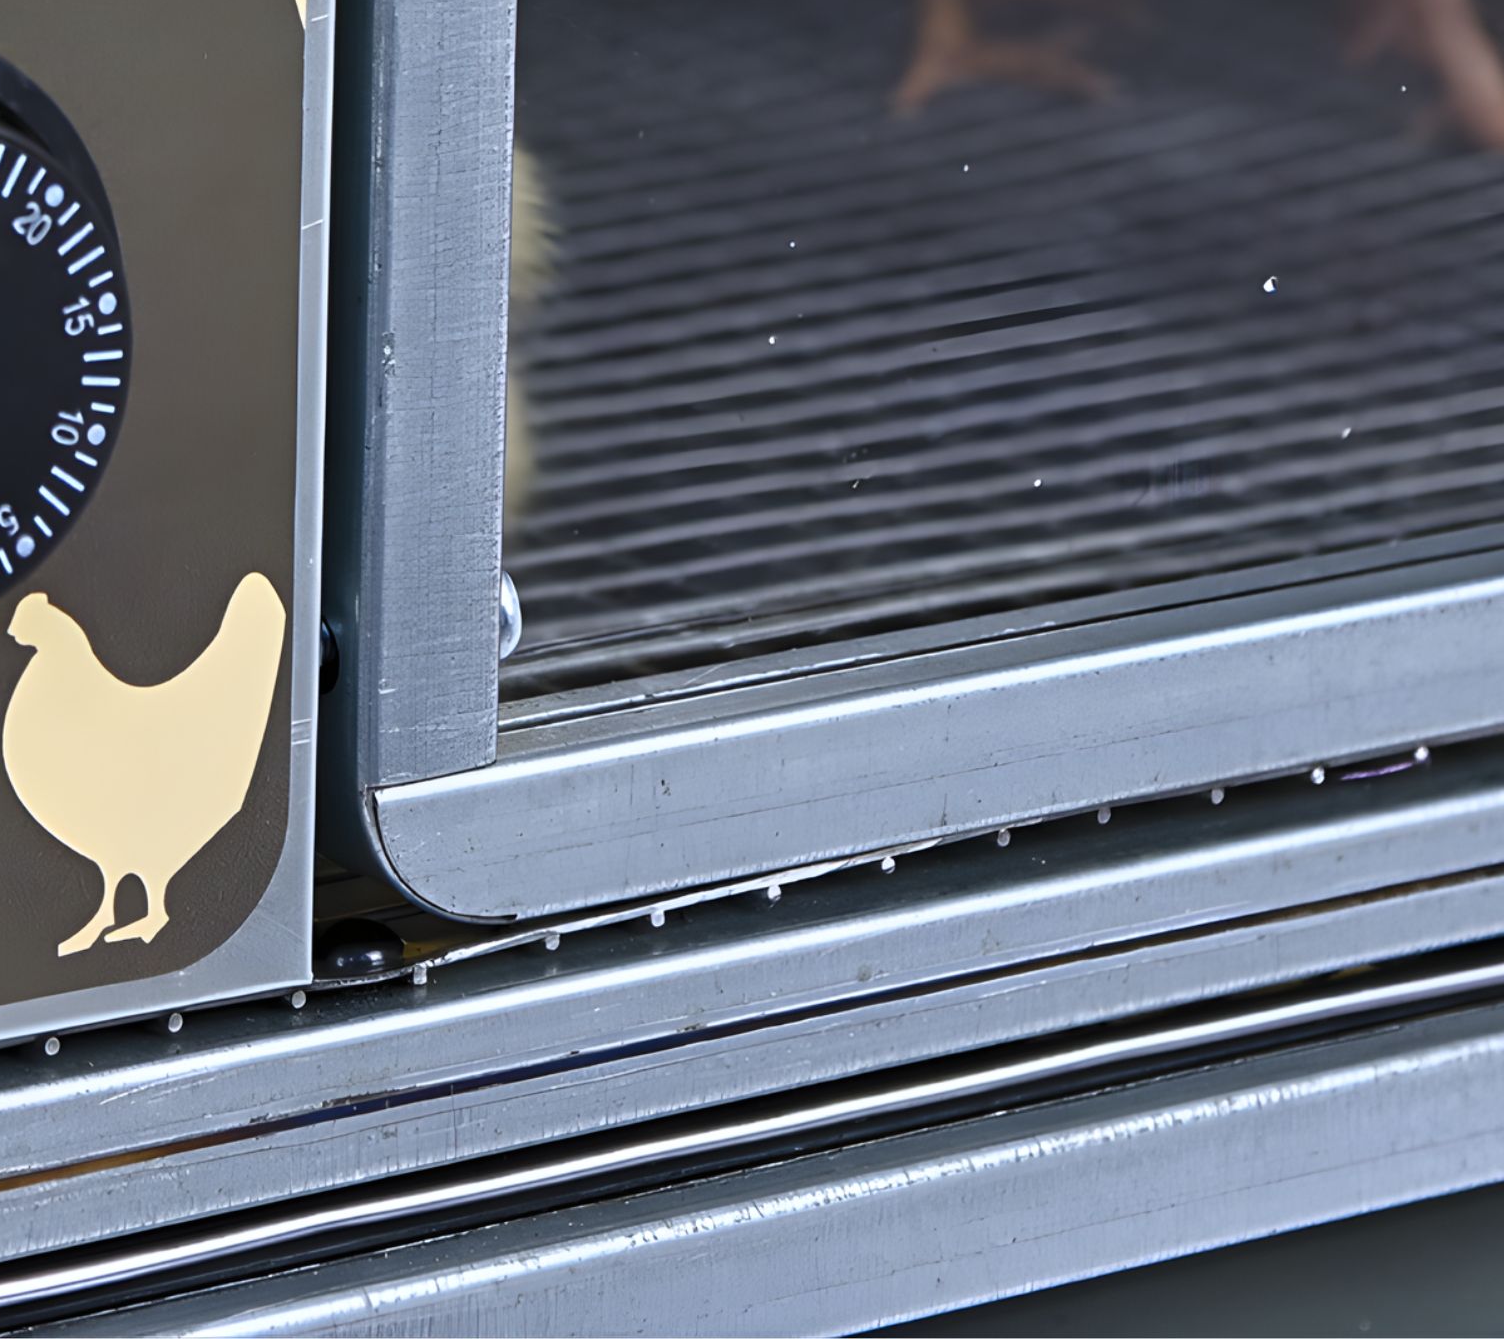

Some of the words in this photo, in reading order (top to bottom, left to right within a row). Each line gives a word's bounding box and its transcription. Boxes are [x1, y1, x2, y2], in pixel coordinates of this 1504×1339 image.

[11, 202, 52, 246] 20
[62, 295, 93, 336] 15
[51, 409, 84, 445] 10
